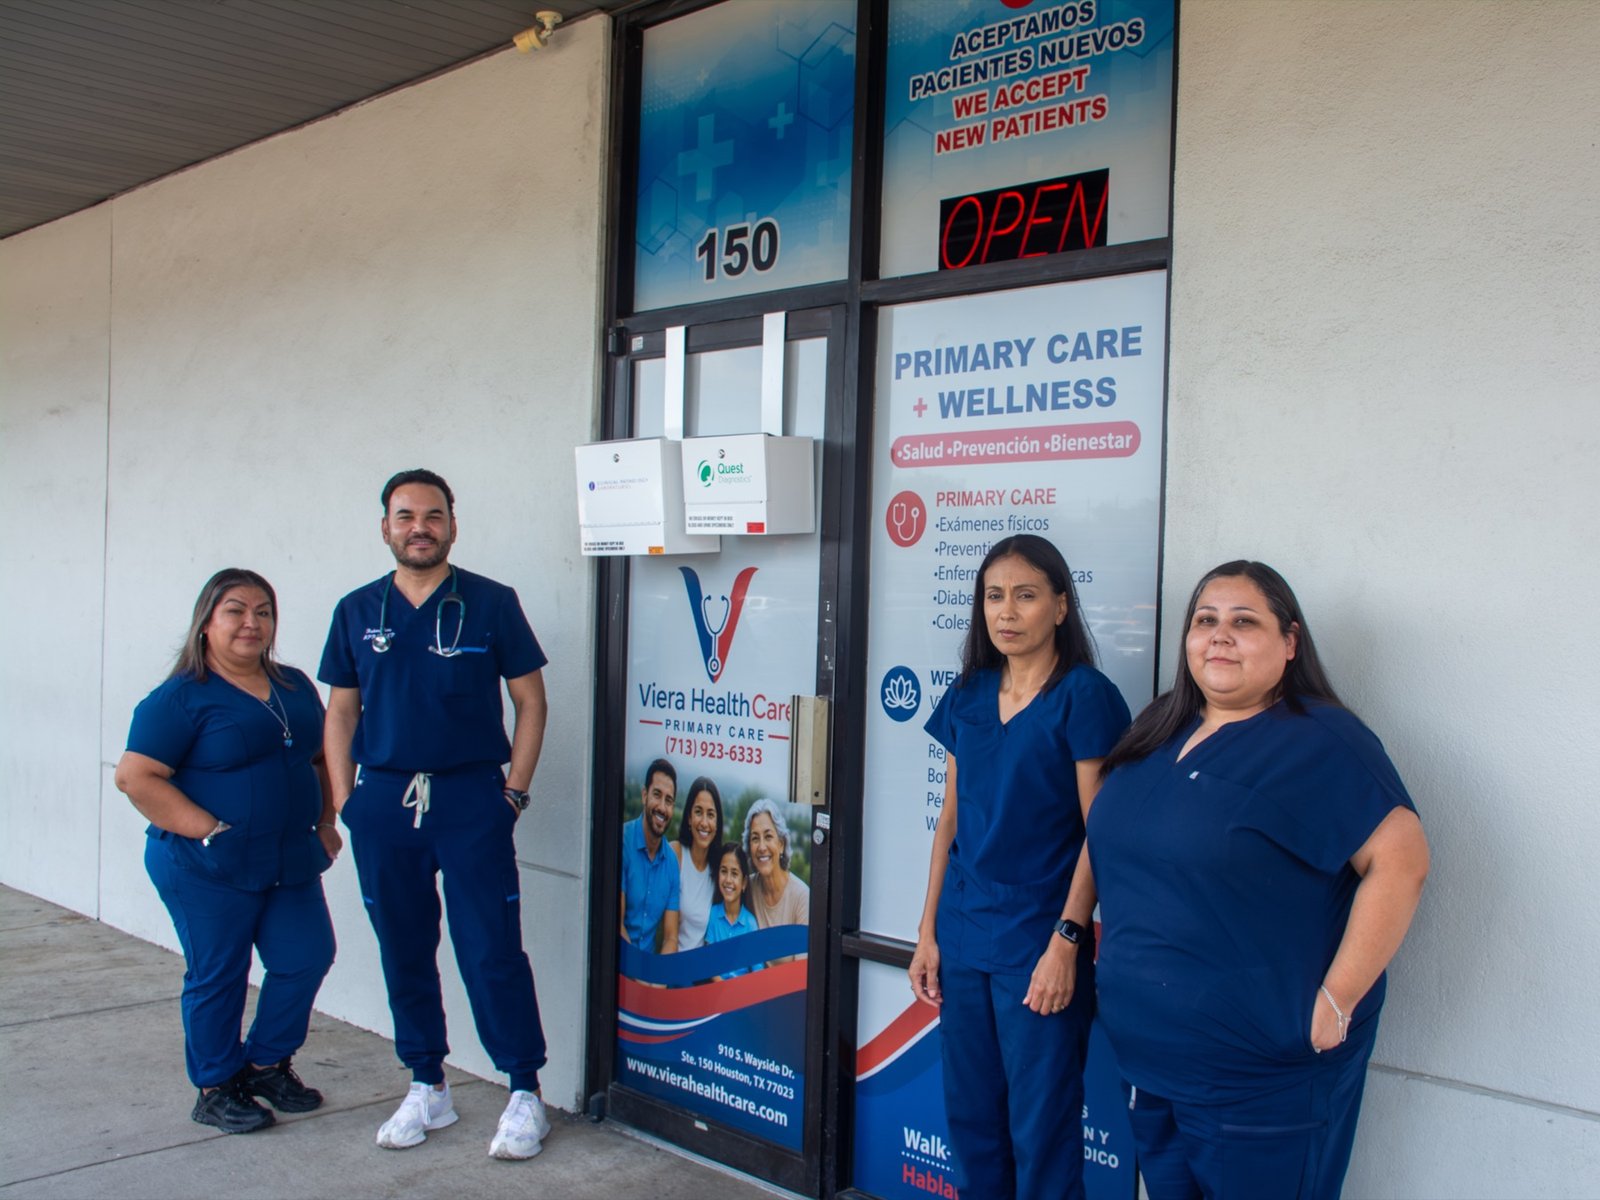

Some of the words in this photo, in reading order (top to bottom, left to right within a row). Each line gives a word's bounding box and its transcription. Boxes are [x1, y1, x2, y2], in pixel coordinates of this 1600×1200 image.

[951, 1, 1094, 57] ACEPTAMOS
[911, 49, 1032, 98] PACIENTES
[1040, 21, 1142, 66] NUEVOS
[954, 93, 988, 118] WE
[994, 68, 1088, 110] ACCEPT
[937, 125, 985, 154] NEW
[992, 98, 1107, 140] PATIENTS
[942, 177, 1108, 269] OPEN
[698, 222, 778, 280] 150
[895, 337, 1036, 380] PRIMARY
[1047, 325, 1142, 364] CARE
[938, 377, 1117, 419] WELLNESS
[718, 463, 744, 474] Quest
[936, 490, 1006, 508] PRIMARY
[1010, 488, 1056, 505] CARE
[1007, 515, 1049, 531] físicos
[639, 683, 685, 711] Viera
[665, 719, 721, 736] PRIMARY
[729, 726, 764, 741] CARE
[665, 736, 697, 758] (713)
[700, 741, 763, 765] 923-6333
[681, 1051, 696, 1066] Ste.
[699, 1057, 713, 1072] 150
[714, 1063, 752, 1087] Houston,
[753, 1075, 765, 1091] TX
[767, 1080, 794, 1099] 77023
[718, 1043, 734, 1059] 910
[735, 1049, 743, 1062] S.
[744, 1052, 780, 1076] Wayside
[782, 1065, 795, 1079] Dr.
[626, 1056, 788, 1127] www.vierahealthcare.com
[904, 1126, 951, 1160] Walk-
[1084, 1145, 1119, 1168] DICO
[1099, 1129, 1109, 1145] Y
